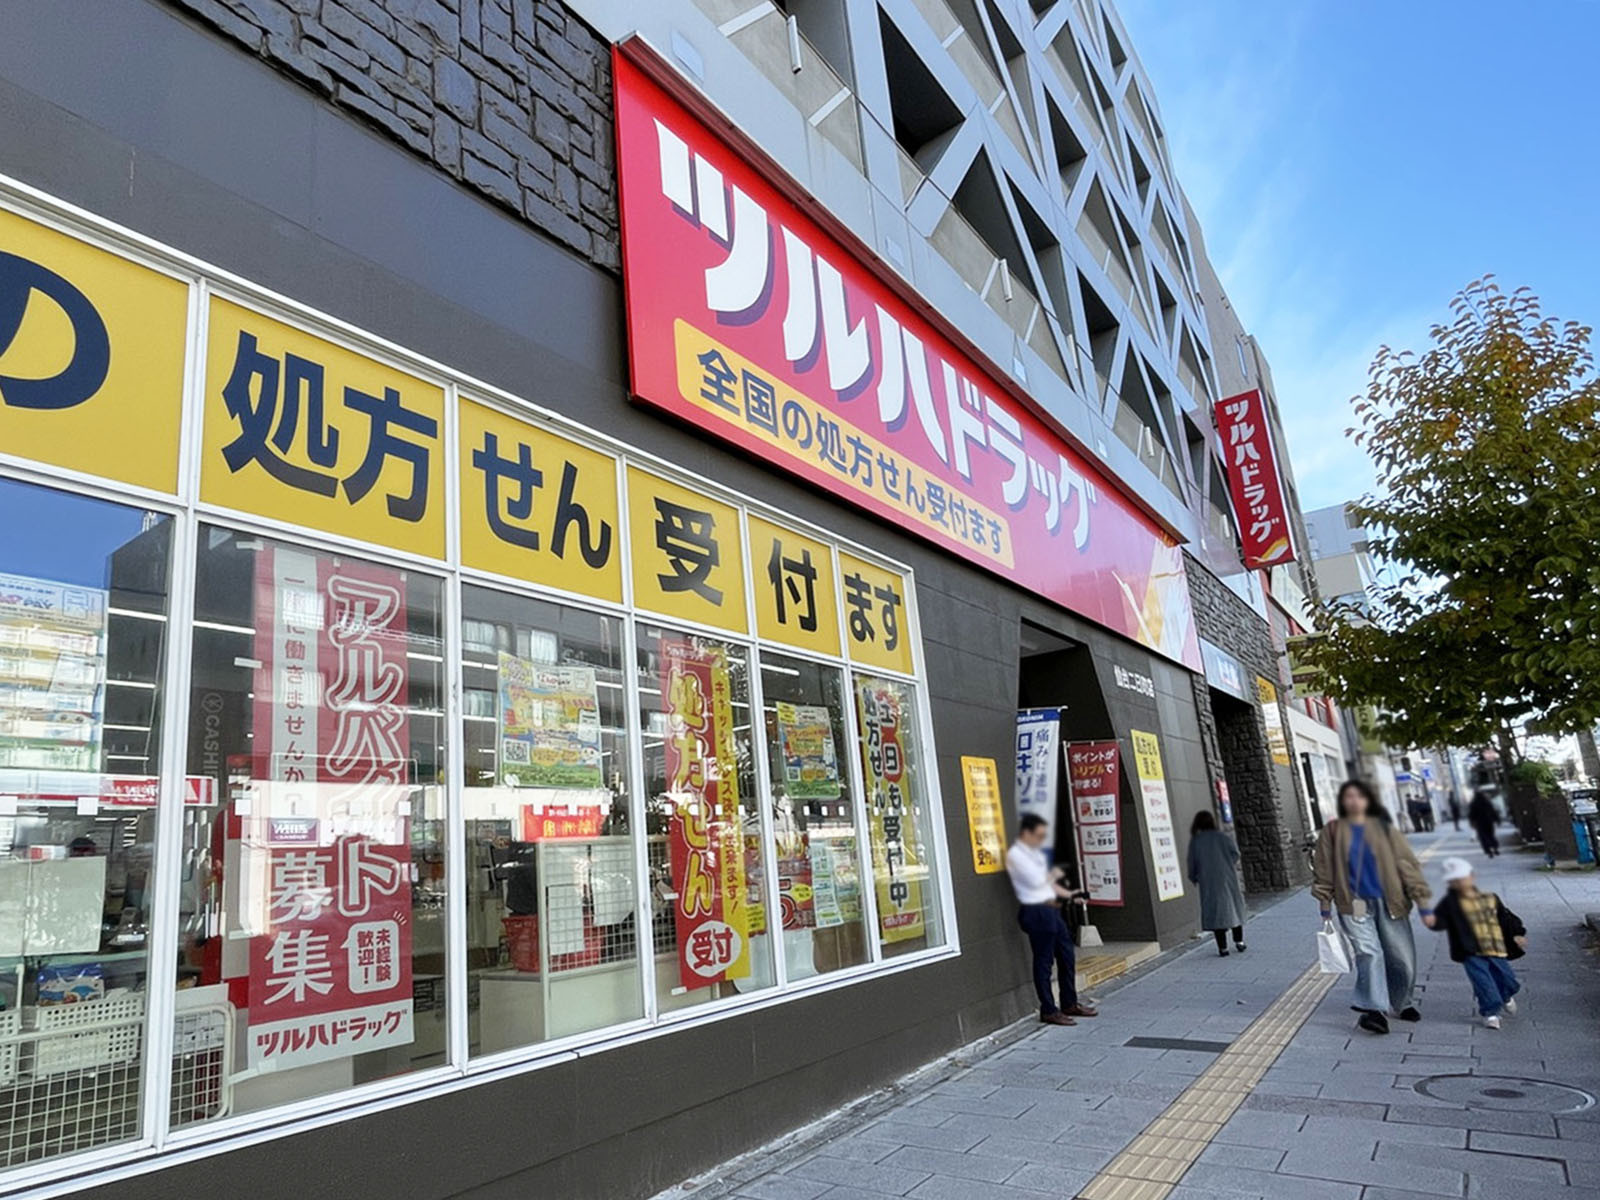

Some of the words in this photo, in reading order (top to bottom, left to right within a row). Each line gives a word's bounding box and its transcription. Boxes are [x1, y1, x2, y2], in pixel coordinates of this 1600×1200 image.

[654, 117, 1096, 550] ツルハドラッグ
[697, 348, 1003, 554] 全国の処方せん受付ます
[1225, 399, 1279, 543] ツルハドラッグ
[264, 851, 334, 1006] 募集
[692, 927, 735, 971] 受付
[257, 1011, 404, 1057] ツルハドラッグ
